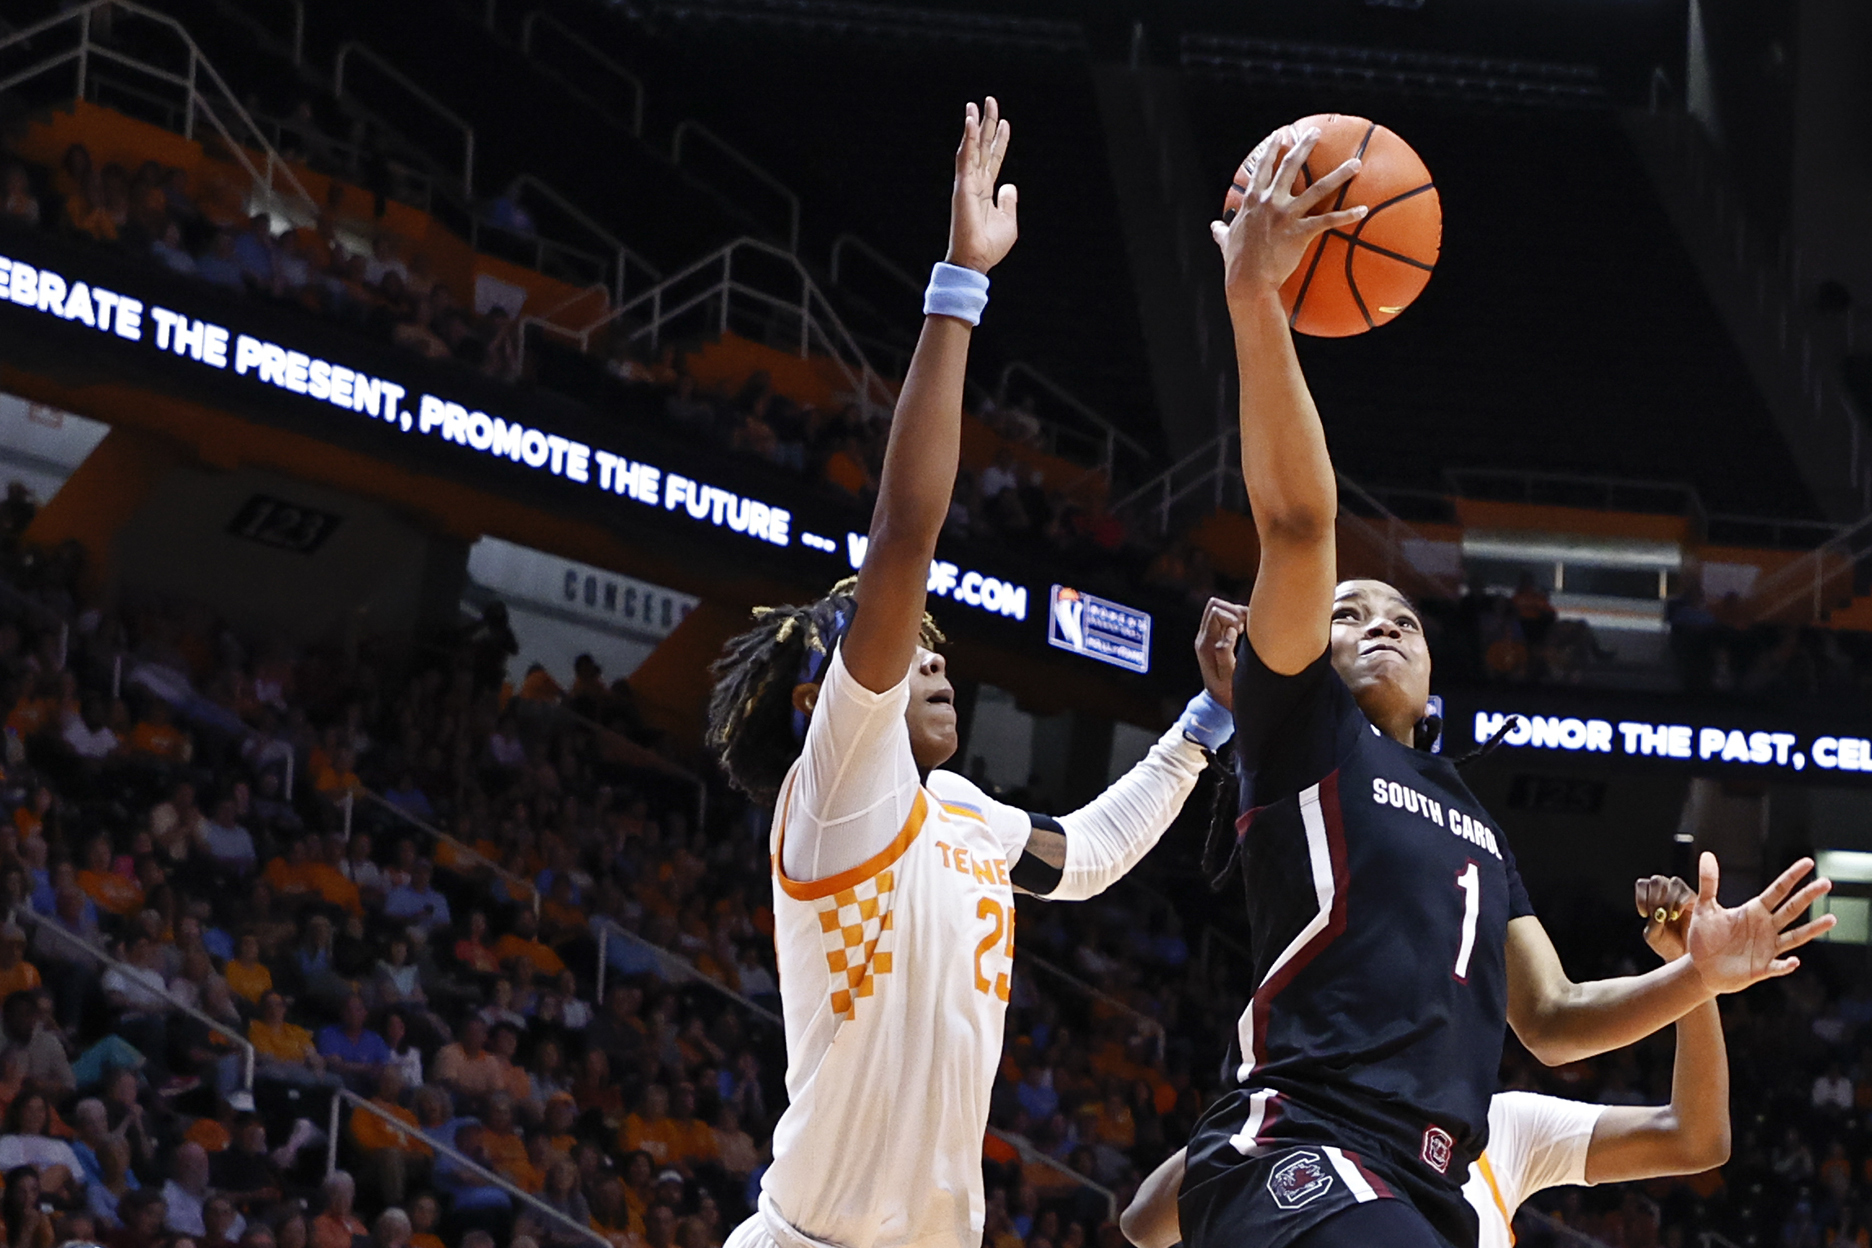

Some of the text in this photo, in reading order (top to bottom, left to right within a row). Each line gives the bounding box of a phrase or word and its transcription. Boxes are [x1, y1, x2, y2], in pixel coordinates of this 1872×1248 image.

[150, 307, 230, 368] THE
[235, 334, 413, 432] PRESENT,
[419, 394, 592, 483] PROMOTE
[594, 450, 662, 505] THE
[664, 473, 792, 547] FUTURE
[1475, 711, 1613, 752] HONOR
[1618, 722, 1693, 758] THE
[1699, 727, 1807, 771] PAST,
[1372, 777, 1445, 828] SOUTH
[1454, 859, 1480, 982] 1
